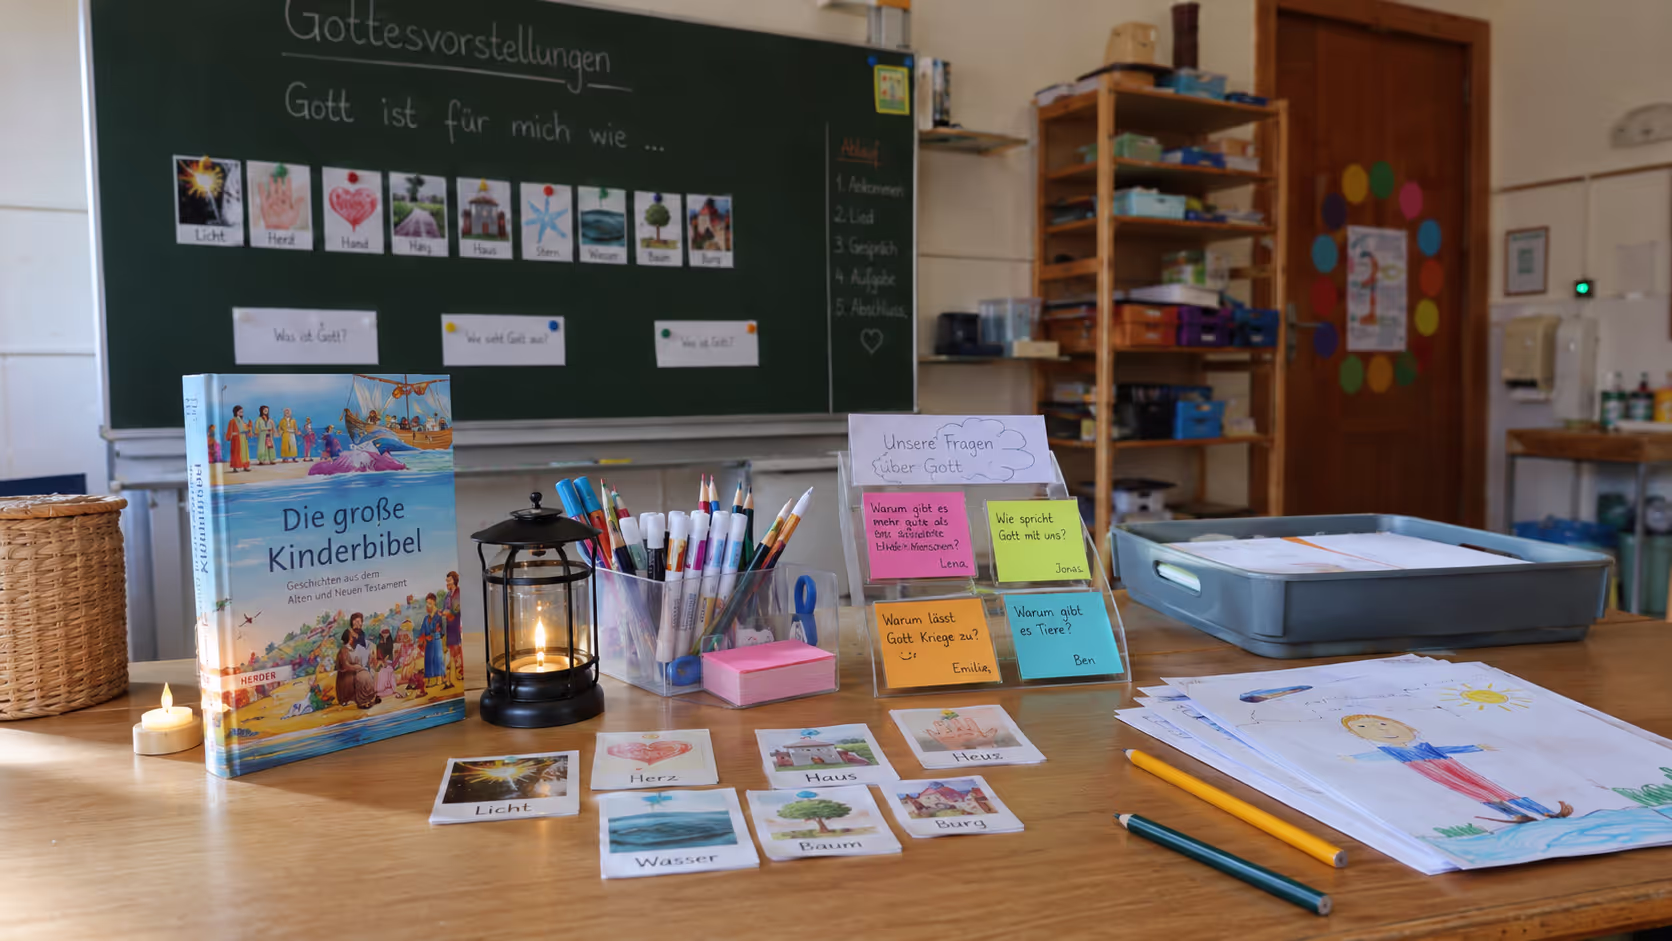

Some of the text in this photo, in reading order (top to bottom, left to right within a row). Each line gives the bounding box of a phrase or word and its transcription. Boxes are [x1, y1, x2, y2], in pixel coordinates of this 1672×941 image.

[284, 0, 610, 93] Gottesvorstellungen
[285, 82, 354, 123] Gott
[383, 98, 418, 129] ist
[444, 100, 490, 144] für
[512, 112, 570, 144] mich
[590, 123, 627, 149] wie
[850, 208, 874, 224] Lied
[195, 228, 227, 243] Licht
[474, 243, 497, 256] Haus
[537, 246, 560, 258] Stern
[851, 267, 896, 294] Aufgabe
[274, 327, 347, 343] Was ist Gott?
[883, 434, 993, 457] Unsere Fragen
[881, 458, 963, 474] über Gott
[283, 496, 405, 534] Die große
[870, 502, 907, 513] Warum
[913, 503, 932, 518] gibt
[873, 518, 899, 526] mehr
[934, 517, 949, 526] als
[996, 512, 1054, 528] Wie spricht
[999, 529, 1066, 541] Gott mit uns?
[268, 527, 422, 573] Kinderbibel
[286, 570, 380, 591] Geschichten aus dem
[287, 578, 408, 605] Alten und Neuen Testament
[882, 612, 956, 626] Warum lässt
[1013, 605, 1083, 622] Warum gibt
[1020, 622, 1072, 636] es Tiere?
[886, 628, 979, 647] Gott Kriege zu?
[1073, 654, 1096, 666] Ben
[240, 671, 276, 685] HERDER
[629, 773, 679, 783] Herz
[805, 772, 857, 783] Haus
[475, 802, 532, 816] Licht
[935, 818, 987, 831] Burg
[798, 841, 862, 852] Baum
[634, 854, 718, 869] Wasser
